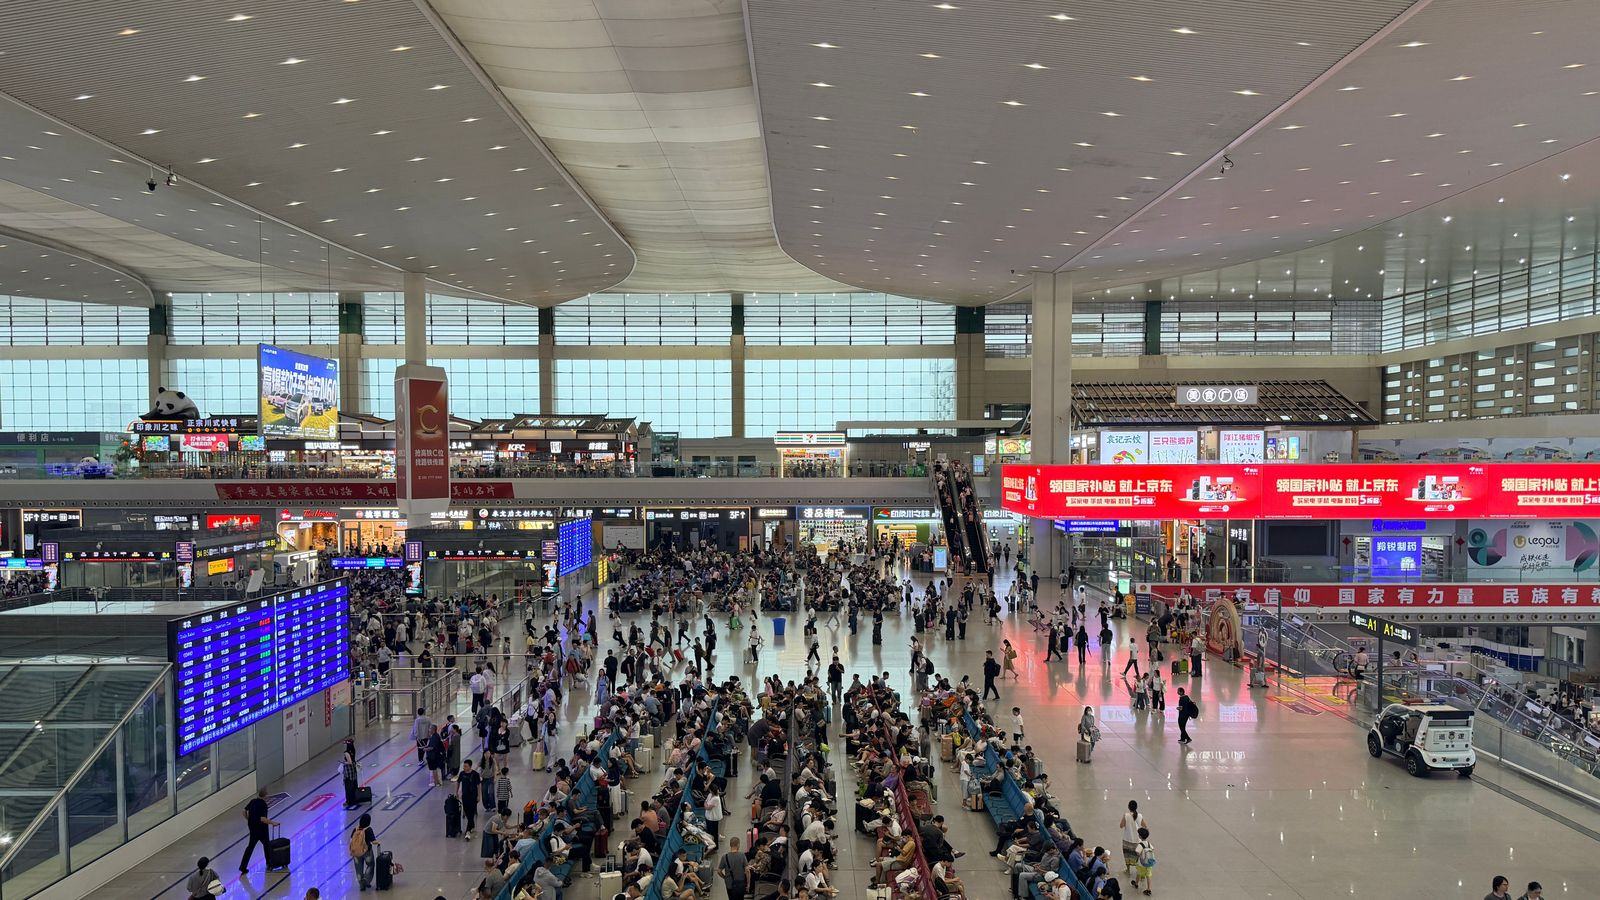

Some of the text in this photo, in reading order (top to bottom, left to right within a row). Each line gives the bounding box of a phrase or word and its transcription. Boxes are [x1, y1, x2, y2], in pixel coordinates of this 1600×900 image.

[1186, 388, 1249, 403] 美食广场
[137, 423, 178, 431] 印象川之味
[187, 419, 238, 427] 正宗川式快餐
[17, 433, 49, 442] 便利店
[1107, 434, 1142, 444] 袁记云饺
[507, 443, 526, 451] KFC
[1049, 479, 1173, 493] 领国家补贴 就上京东
[1276, 479, 1399, 493] 领国家补贴 就上京东
[1501, 478, 1600, 492] 领国家补贴 就上
[23, 513, 34, 522] 3F
[314, 509, 338, 518] Hortons
[729, 511, 740, 520] 3F
[1180, 588, 1311, 604] 民有信仰
[1338, 588, 1480, 605] 国家有力量
[1367, 618, 1377, 631] A1
[1383, 623, 1394, 637] A1
